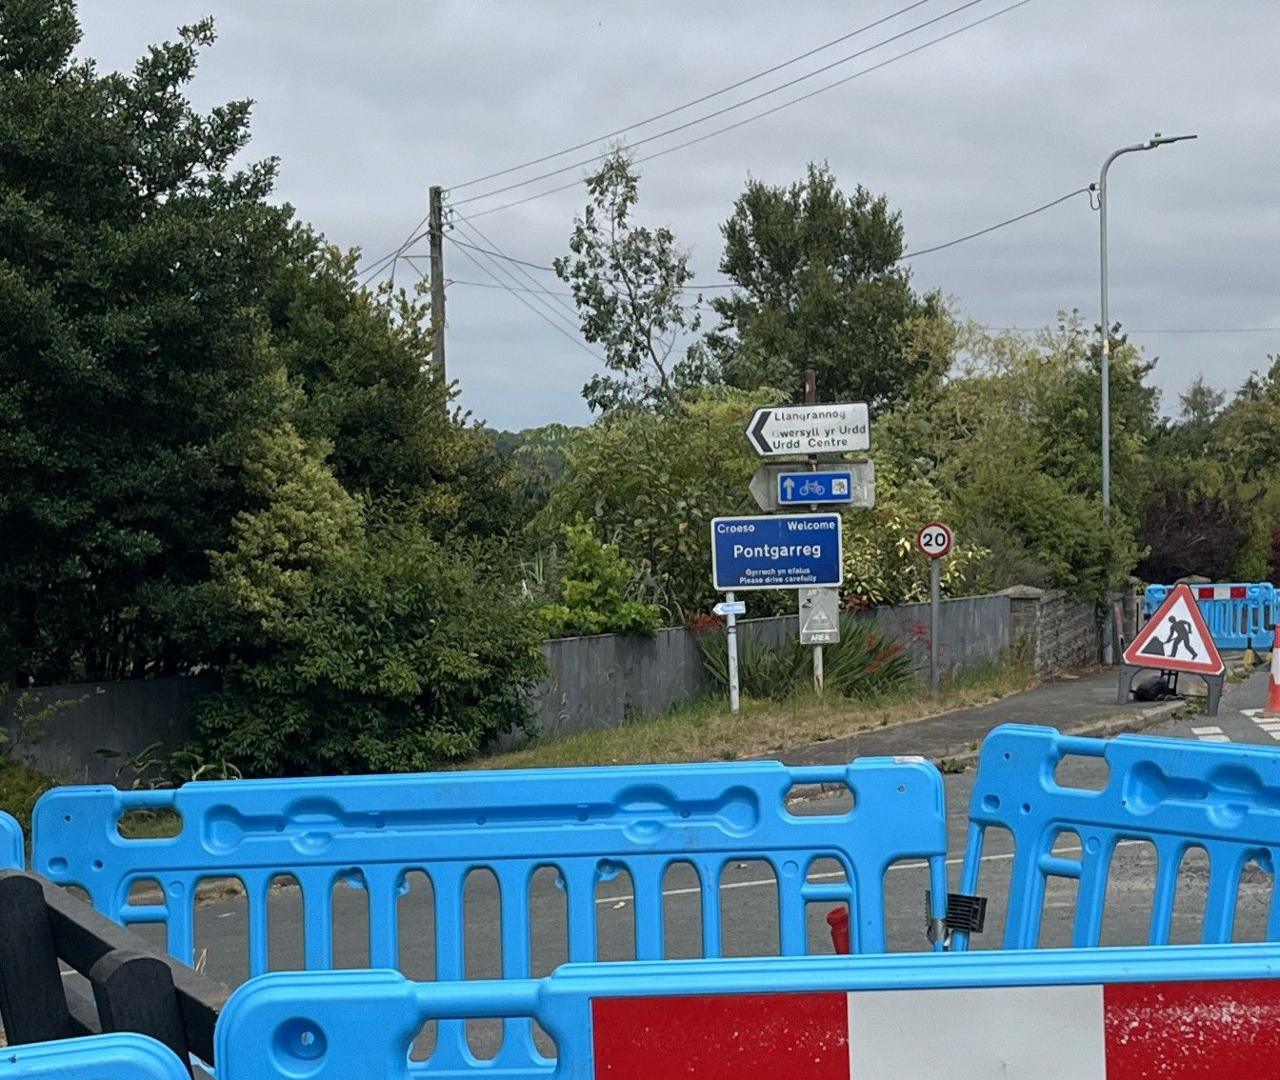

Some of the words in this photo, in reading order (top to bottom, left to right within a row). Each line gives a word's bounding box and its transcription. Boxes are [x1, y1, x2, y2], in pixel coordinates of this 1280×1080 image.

[839, 424, 866, 435] Urdd
[772, 439, 800, 450] Urdd
[717, 523, 755, 534] Croeso
[787, 520, 836, 531] Welcome
[922, 533, 946, 547] 20
[733, 544, 821, 560] Pontgarreg
